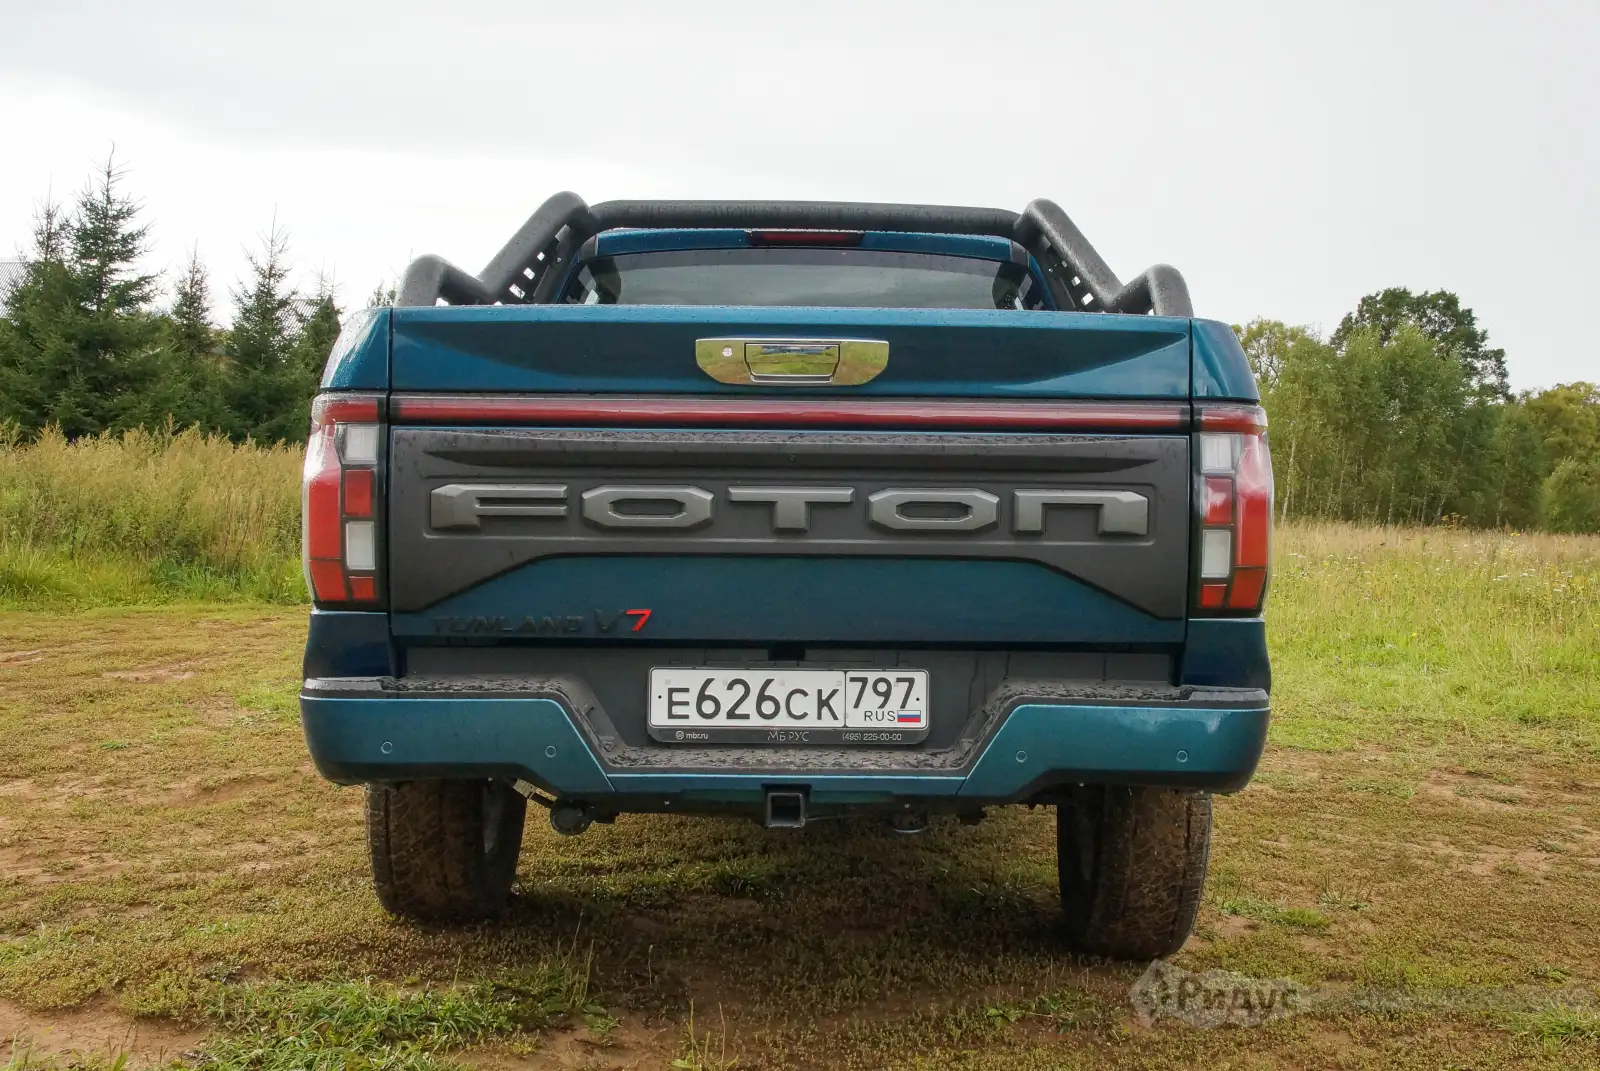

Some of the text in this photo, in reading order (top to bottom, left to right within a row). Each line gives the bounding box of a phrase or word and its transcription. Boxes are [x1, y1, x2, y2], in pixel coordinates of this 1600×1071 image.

[429, 484, 1150, 536] FOTON
[593, 608, 653, 632] V7
[849, 676, 916, 709] 797
[864, 710, 896, 723] RUS
[768, 731, 810, 742] МБ РУС
